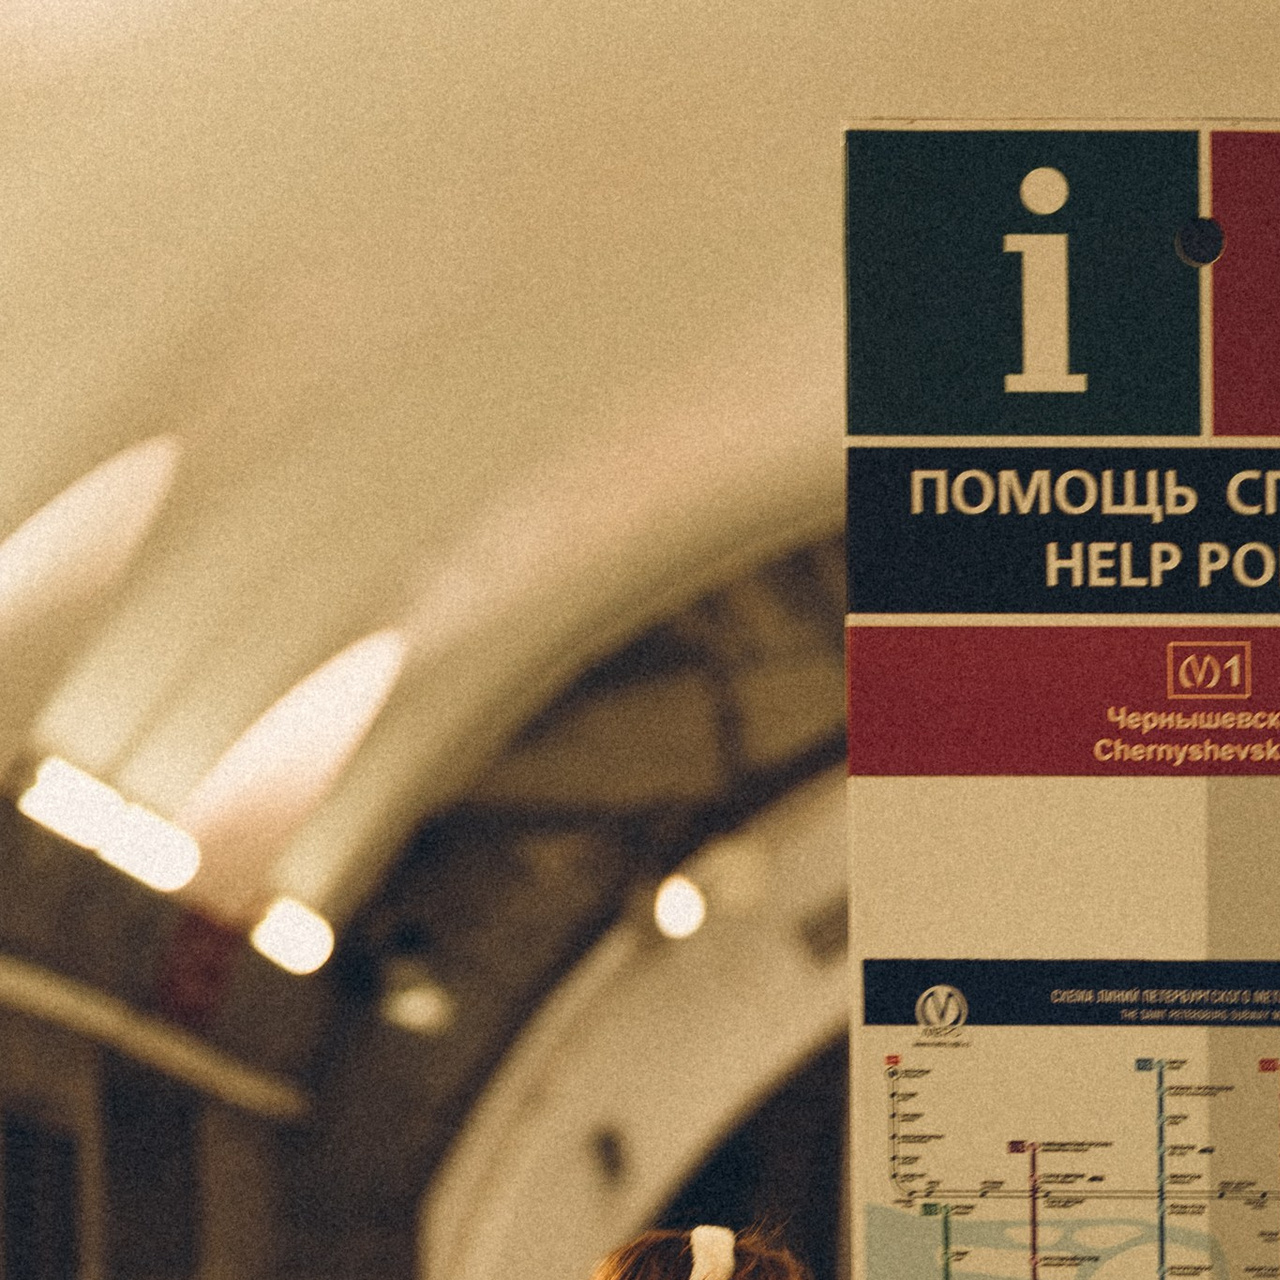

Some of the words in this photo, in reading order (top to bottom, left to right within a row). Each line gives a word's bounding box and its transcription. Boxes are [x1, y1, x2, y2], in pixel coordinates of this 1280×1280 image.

[1002, 166, 1088, 394] i
[909, 468, 1199, 525] ПОМОЩЬ
[1045, 541, 1183, 589] HELP
